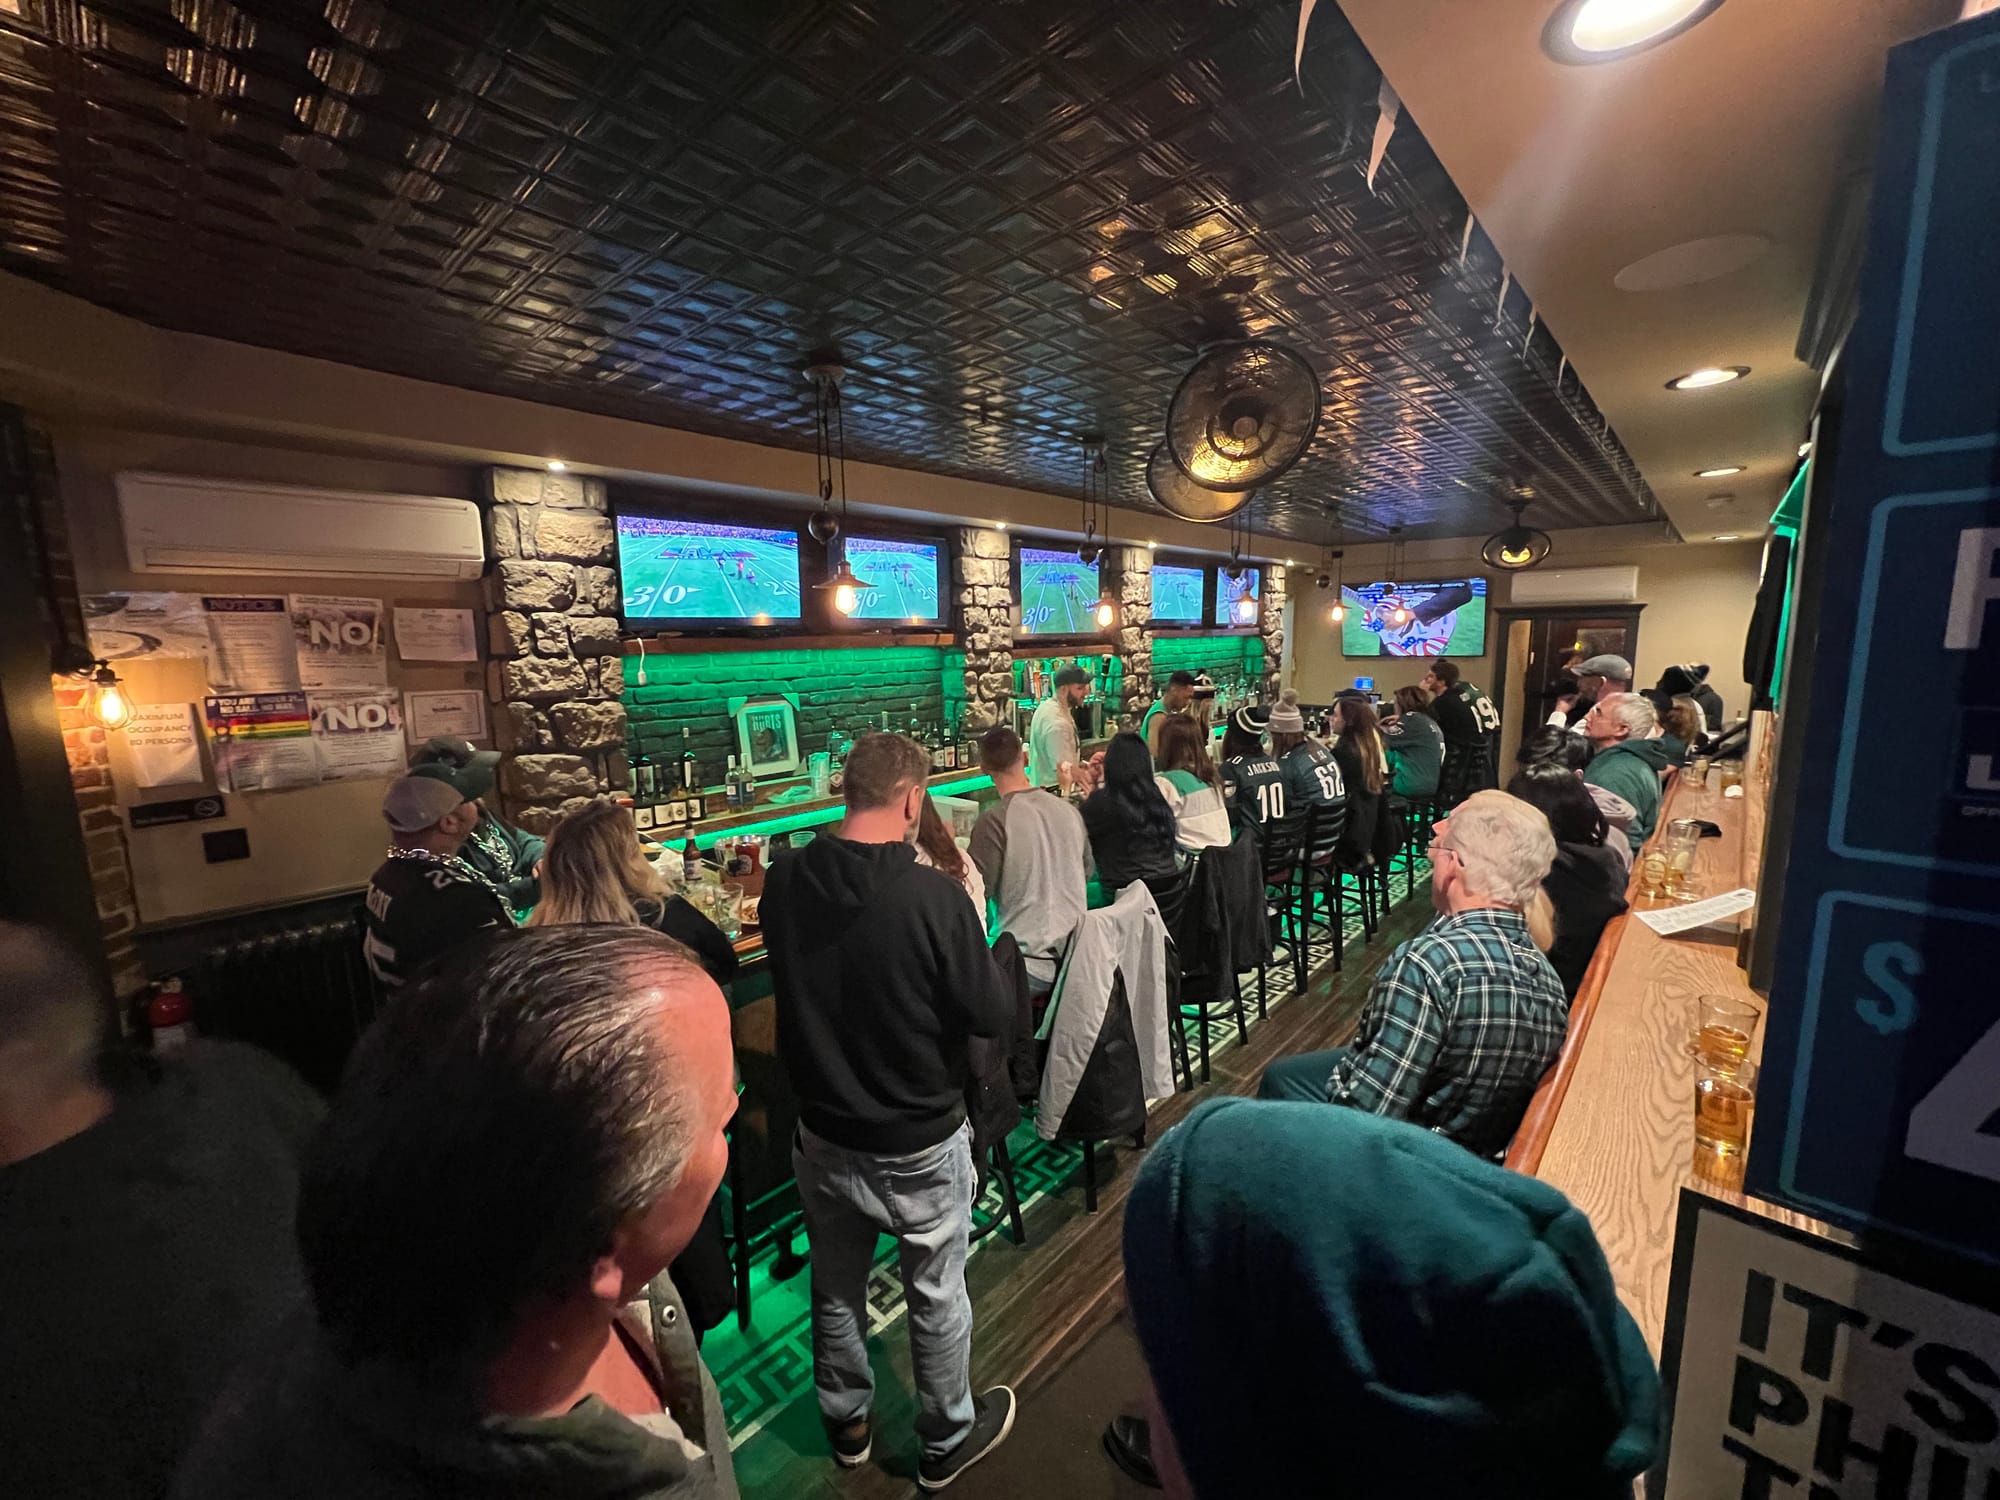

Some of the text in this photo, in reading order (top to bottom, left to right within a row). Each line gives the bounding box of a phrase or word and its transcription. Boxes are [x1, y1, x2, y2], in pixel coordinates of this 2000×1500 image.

[208, 599, 274, 610] NOTICE
[1314, 761, 1346, 800] 62
[1256, 782, 1285, 824] 10
[1740, 1269, 2000, 1445] IT'S
[1729, 1354, 2000, 1500] PHI
